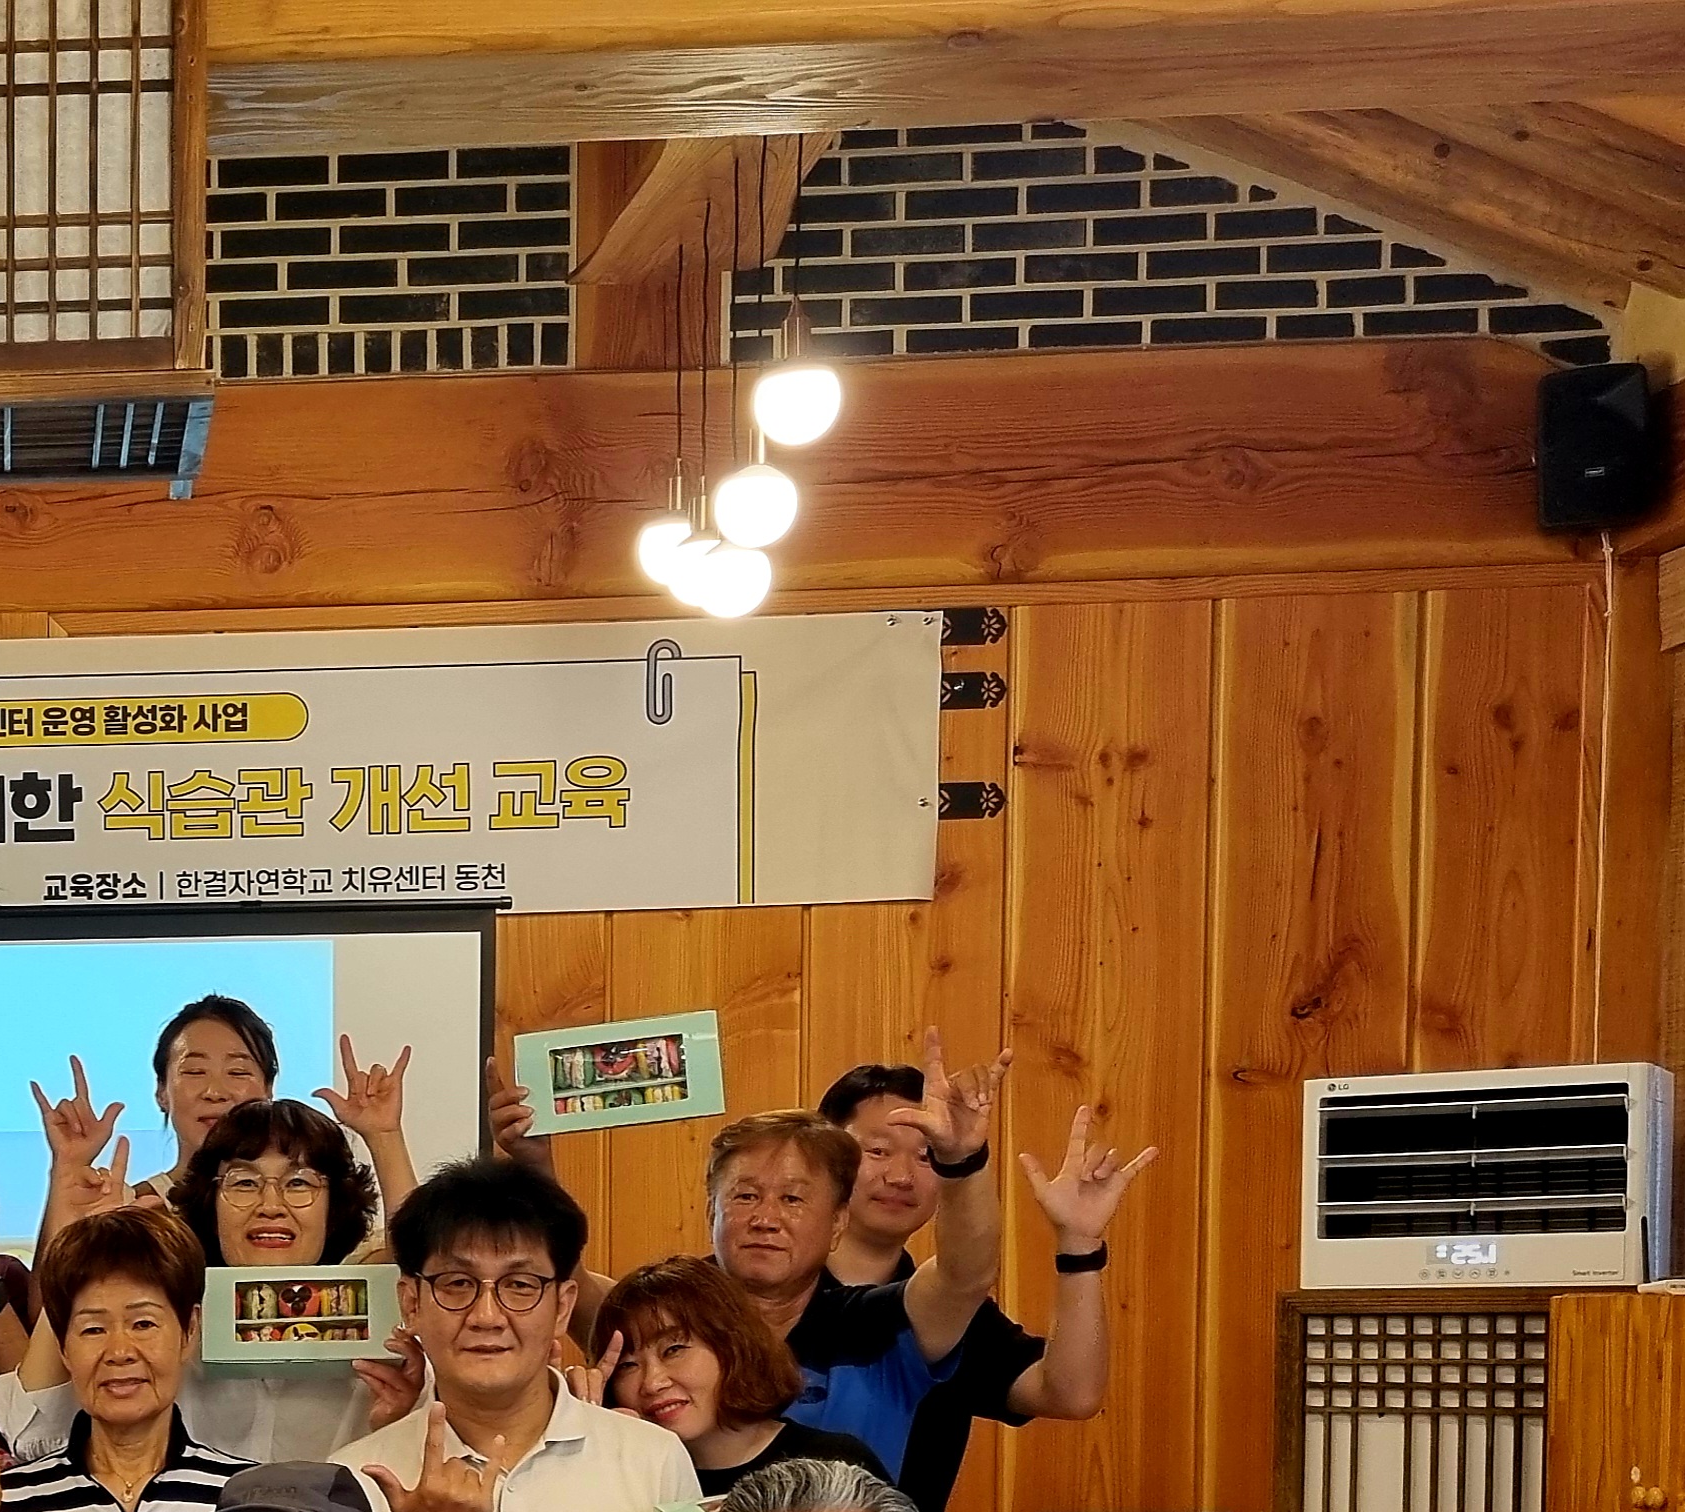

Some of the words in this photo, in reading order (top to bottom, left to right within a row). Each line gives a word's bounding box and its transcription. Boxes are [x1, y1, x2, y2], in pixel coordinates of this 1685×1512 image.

[42, 707, 95, 736] 운영
[104, 705, 187, 735] 활성화
[194, 703, 247, 732] 사업
[97, 767, 313, 840] 식습관
[329, 763, 470, 835] 개선
[489, 756, 630, 830] 교육
[44, 873, 146, 900] 교육장소
[176, 868, 333, 897] 한결자연학교
[342, 865, 445, 893] 치유센터
[455, 863, 505, 890] 동천
